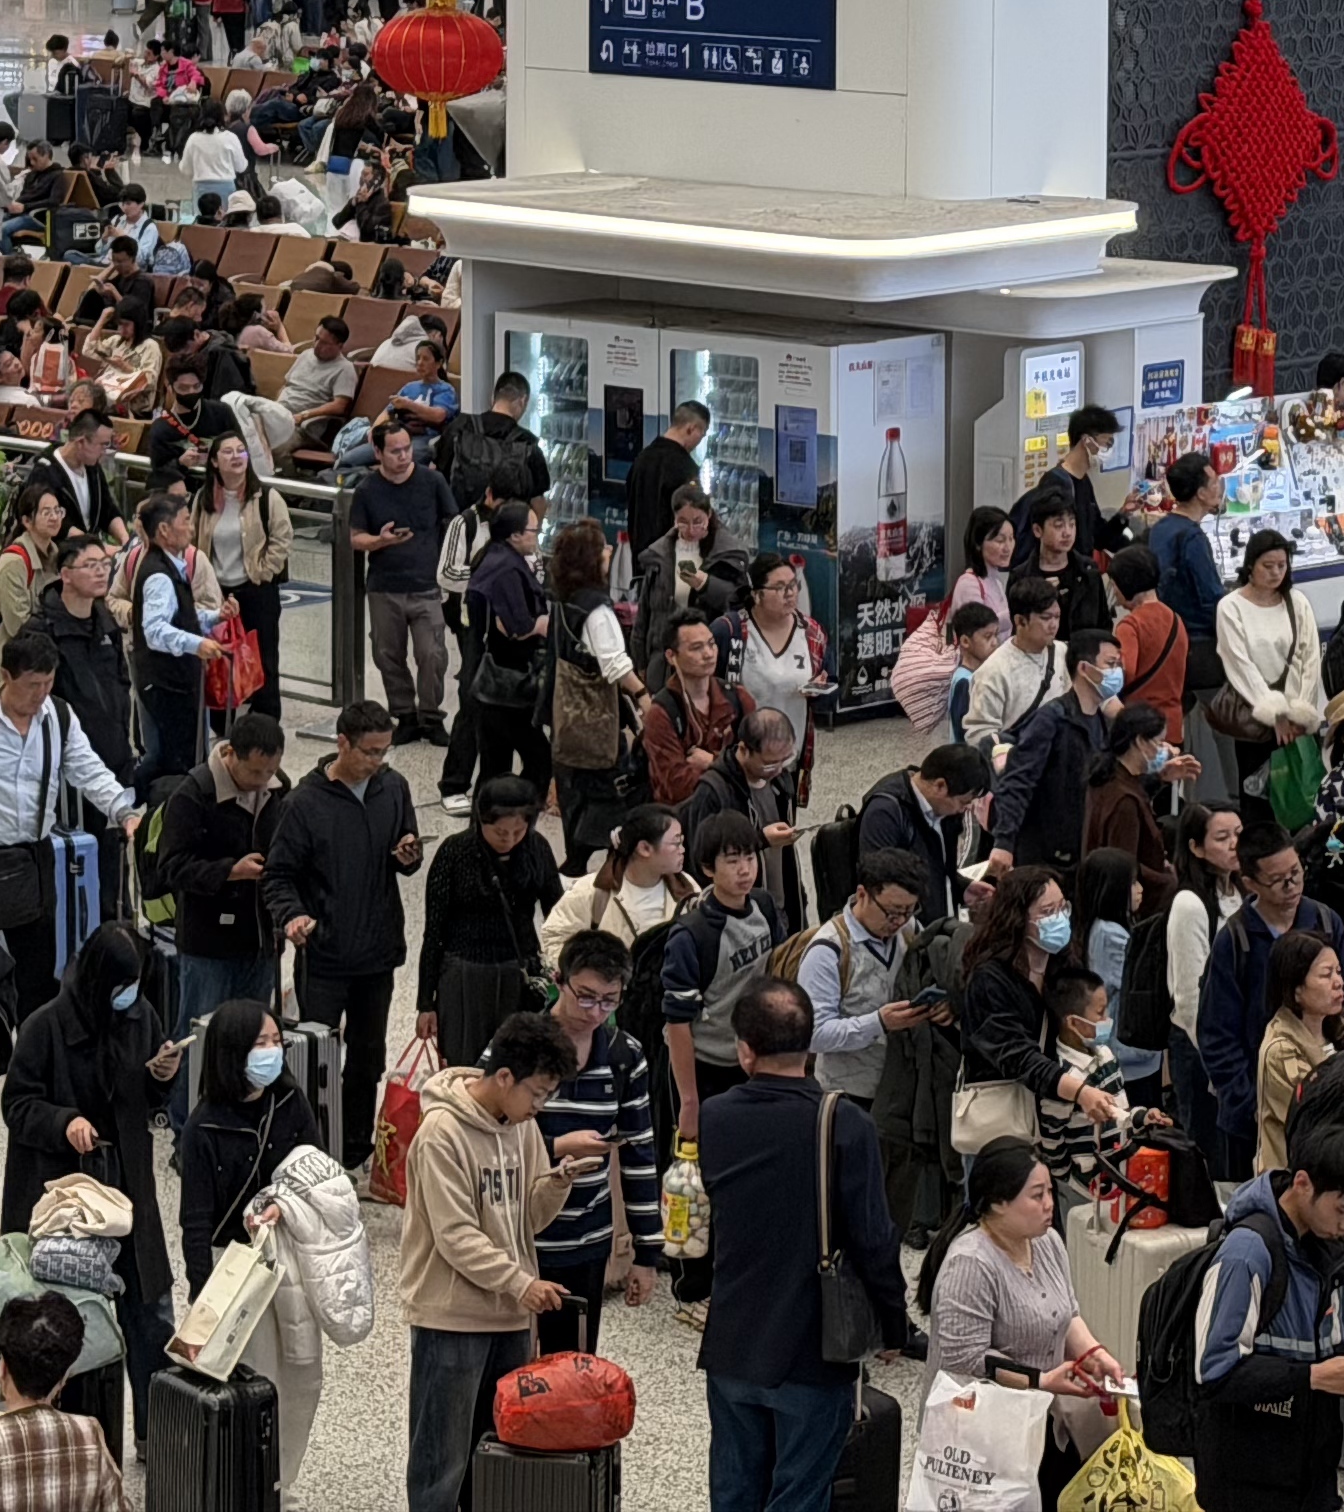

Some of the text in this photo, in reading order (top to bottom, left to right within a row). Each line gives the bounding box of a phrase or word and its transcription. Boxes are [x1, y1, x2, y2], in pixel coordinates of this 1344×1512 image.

[645, 41, 690, 69] 检票口 1
[1034, 367, 1071, 384] 手机充电站
[794, 654, 805, 669] 7
[943, 1445, 971, 1465] OLD
[923, 1455, 997, 1486] PULTENEY
